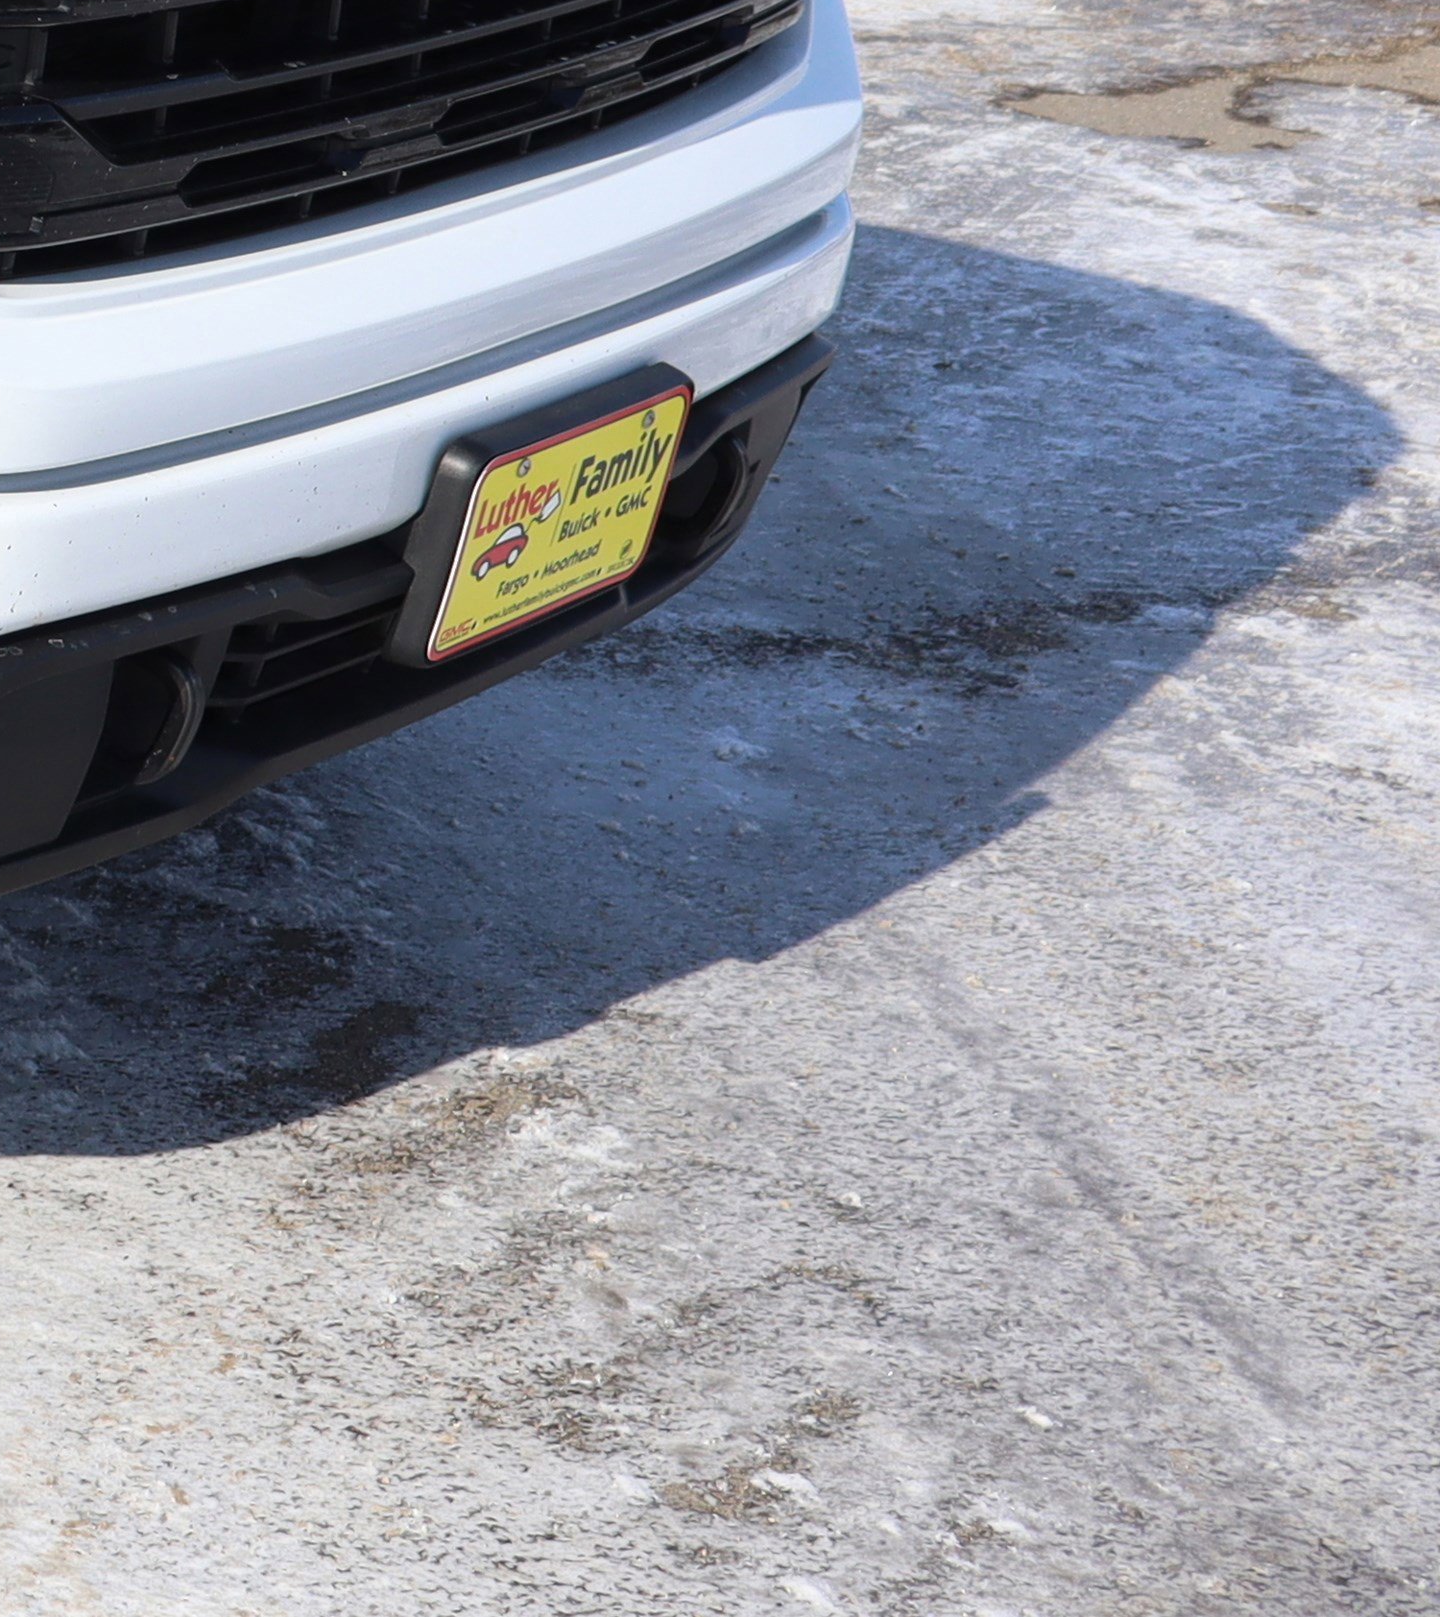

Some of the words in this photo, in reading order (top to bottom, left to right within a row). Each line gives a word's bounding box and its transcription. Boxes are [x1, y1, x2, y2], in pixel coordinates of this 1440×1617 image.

[569, 428, 674, 506] Family
[472, 478, 560, 540] Luther
[557, 508, 601, 544] Buick
[615, 485, 653, 520] GMC
[496, 573, 531, 599] Fargo
[540, 538, 603, 580] Moorhead
